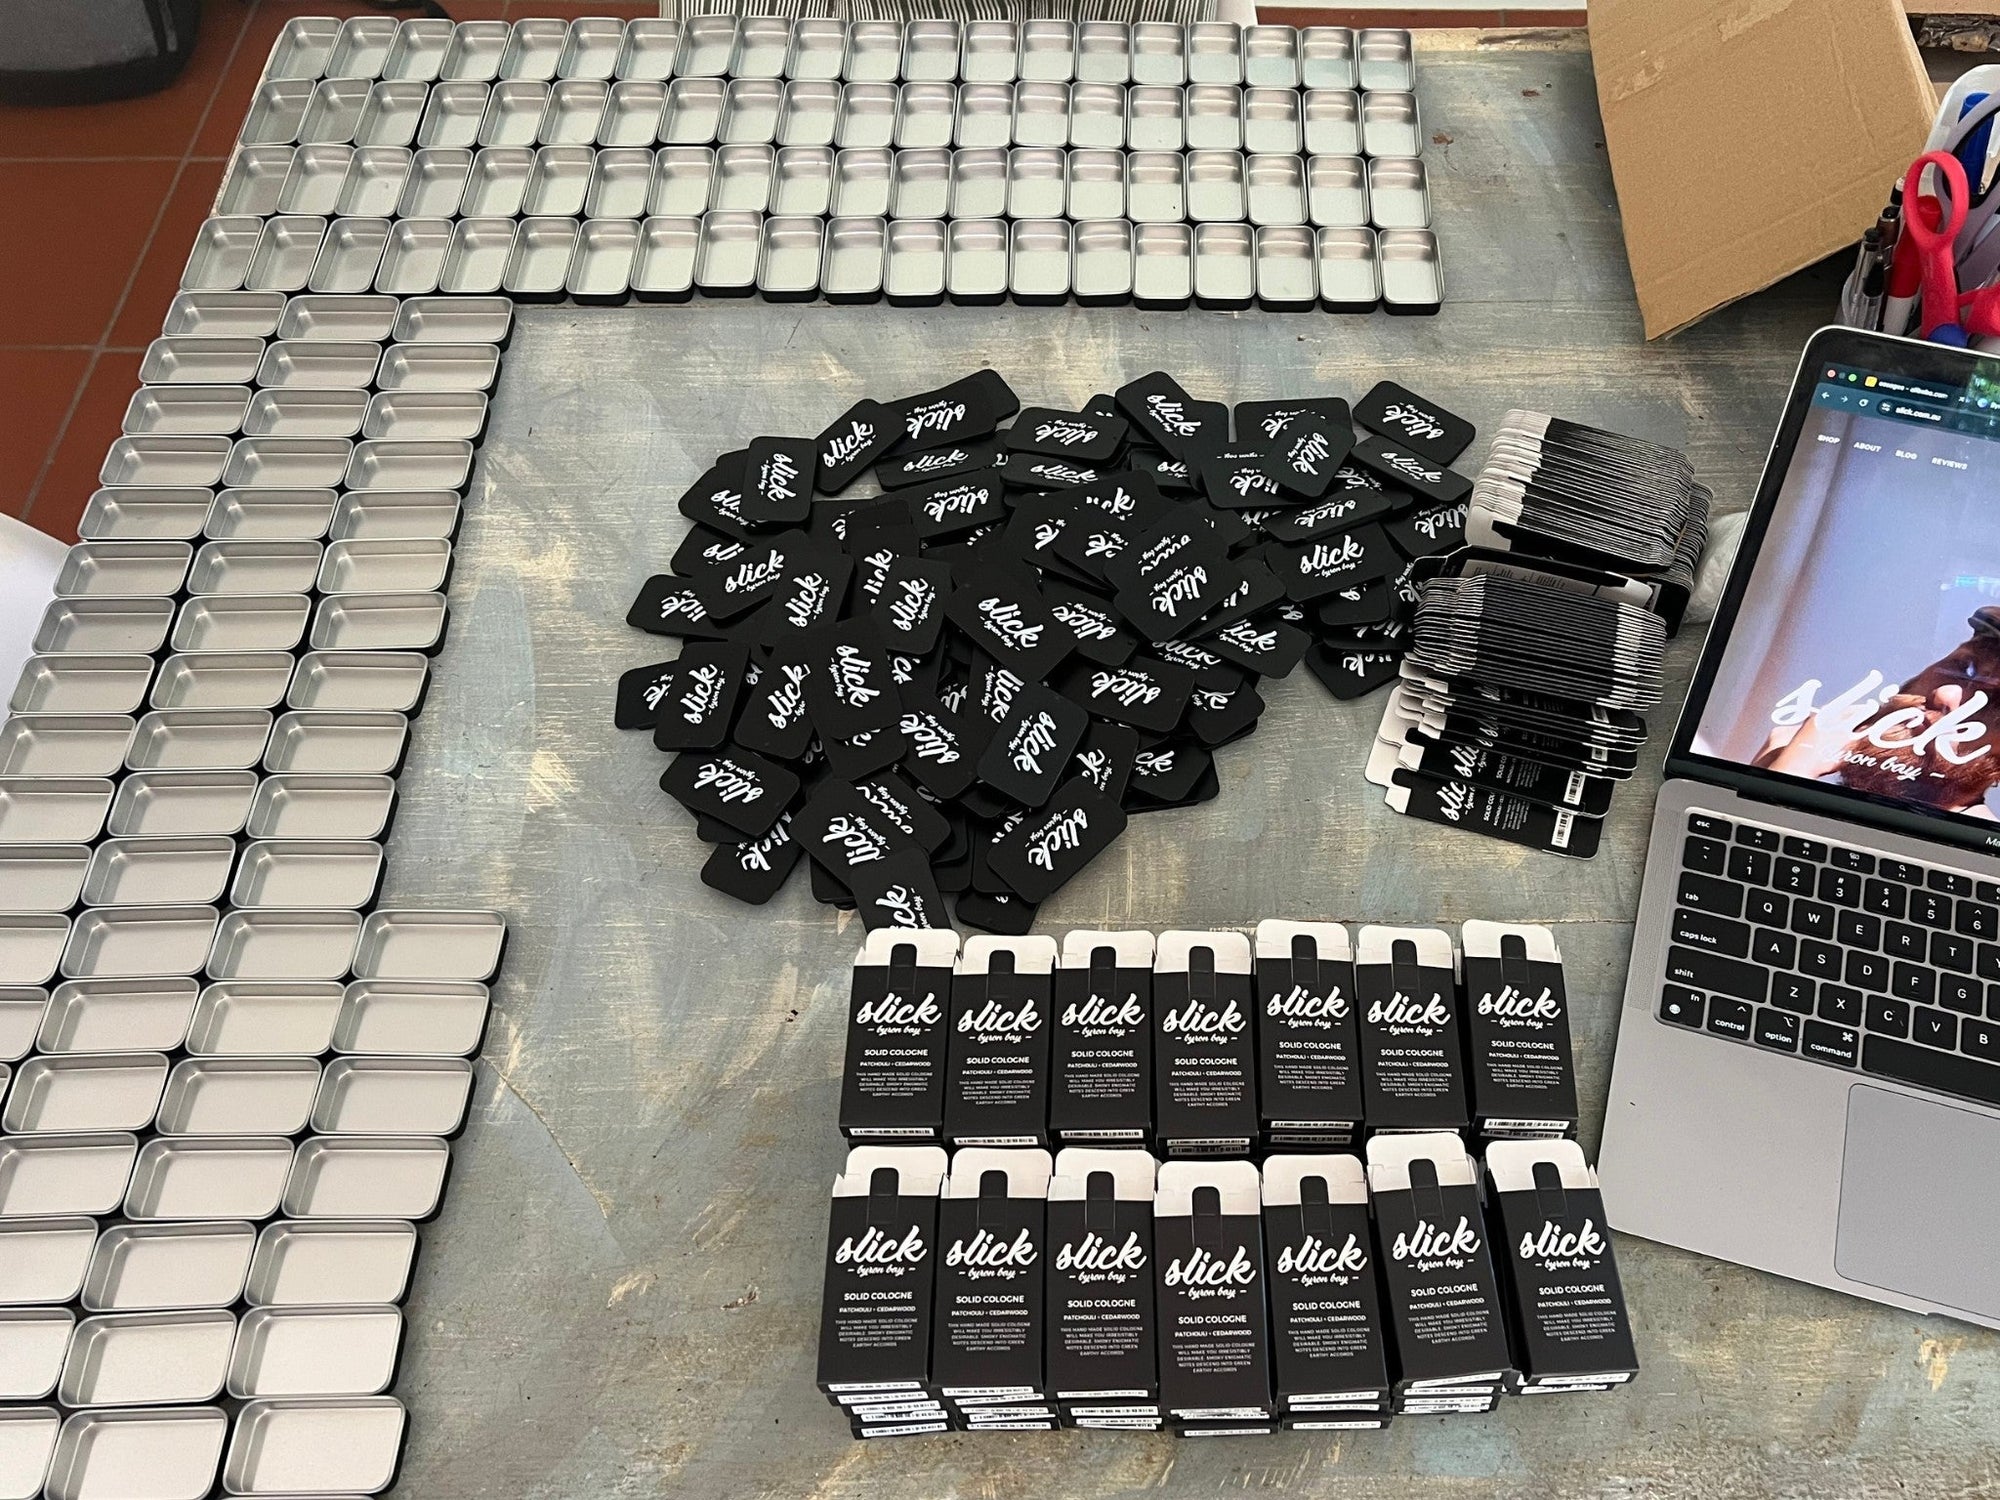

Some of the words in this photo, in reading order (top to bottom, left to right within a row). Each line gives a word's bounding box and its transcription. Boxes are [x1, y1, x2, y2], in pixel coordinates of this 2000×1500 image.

[906, 400, 966, 439] slick
[1147, 393, 1202, 436] slick
[1382, 402, 1446, 439] slick
[1035, 419, 1098, 446] slick
[822, 420, 874, 467] slick
[1292, 432, 1330, 475] slick
[1817, 434, 1840, 445] SHOP
[1854, 442, 1882, 452] ABOUT
[1895, 450, 1918, 460] BLOG
[1932, 457, 1968, 470] REVIEWS
[903, 449, 969, 472] slick
[1030, 464, 1098, 484] slick
[1381, 453, 1442, 483] slick
[767, 453, 799, 502] slick
[923, 485, 989, 522] slick
[1294, 500, 1356, 527] slick
[1300, 534, 1364, 574] slick
[720, 549, 784, 593] slick
[1152, 566, 1207, 619] slick
[785, 573, 824, 627] slick
[890, 578, 930, 631] slick
[978, 598, 1044, 649] slick
[1052, 603, 1116, 640] slick
[835, 645, 880, 707] slick
[680, 664, 720, 724] slick
[1091, 669, 1161, 706] slick
[767, 664, 811, 729] slick
[1771, 669, 1992, 765] slick
[900, 713, 960, 764] slick
[1013, 711, 1057, 774] slick
[1879, 759, 1922, 781] bay
[694, 759, 764, 803] slick
[1696, 820, 1710, 828] esc
[1027, 808, 1088, 870] slick
[1747, 866, 1752, 875] 1
[1791, 877, 1799, 887] 2
[1685, 893, 1699, 901] tab
[1836, 888, 1843, 897] 3
[1763, 902, 1773, 913] Q
[1881, 899, 1889, 908] 4
[1808, 913, 1820, 923] W
[1927, 909, 1935, 919] 5
[1856, 924, 1863, 935] E
[1973, 920, 1981, 930] 6
[1680, 931, 1699, 940] caps
[1700, 934, 1717, 944] lock
[1902, 935, 1910, 946] R
[1770, 943, 1780, 953] A
[1949, 947, 1957, 956] T
[1817, 954, 1826, 964] S
[1675, 969, 1693, 978] shift
[1863, 965, 1872, 975] D
[1911, 976, 1919, 986] F
[1691, 994, 1700, 1002] fn
[1790, 986, 1798, 998] Z
[1957, 988, 1966, 999] G
[856, 992, 942, 1024] slick
[1267, 985, 1350, 1018] slick
[1367, 991, 1451, 1025] slick
[1478, 985, 1561, 1019] slick
[1836, 998, 1845, 1009] X
[957, 999, 1042, 1032] slick
[1061, 993, 1145, 1026] slick
[1163, 999, 1246, 1032] slick
[1884, 1010, 1893, 1021] C
[876, 1025, 902, 1036] byron
[903, 1025, 921, 1036] bay
[1288, 1017, 1313, 1029] byron
[1314, 1018, 1331, 1030] bay
[1499, 1017, 1525, 1028] byron
[1526, 1018, 1543, 1030] bay
[1715, 1019, 1745, 1031] control
[1931, 1021, 1941, 1032] V
[977, 1033, 1003, 1044] byron
[1004, 1032, 1022, 1044] bay
[1081, 1026, 1107, 1038] byron
[1108, 1026, 1125, 1037] bay
[1389, 1025, 1414, 1036] byron
[1416, 1025, 1433, 1037] bay
[1765, 1032, 1792, 1043] option
[1184, 1033, 1209, 1045] byron
[1210, 1033, 1228, 1045] bay
[1279, 1041, 1303, 1049] SOLID
[1303, 1042, 1341, 1050] COLOGNE
[1516, 1041, 1554, 1050] COLOGNE
[1979, 1034, 1988, 1044] B
[1071, 1050, 1095, 1058] SOLID
[1405, 1049, 1444, 1057] COLOGNE
[1810, 1044, 1852, 1058] command
[991, 1056, 1029, 1064] COLOGNE
[835, 1225, 927, 1264] slick
[1392, 1216, 1481, 1261] slick
[1519, 1218, 1606, 1259] slick
[946, 1228, 1038, 1266] slick
[1056, 1231, 1147, 1270] slick
[1277, 1233, 1367, 1273] slick
[857, 1265, 884, 1278] byron
[885, 1264, 905, 1277] bay
[1165, 1245, 1256, 1286] slick
[1417, 1259, 1444, 1272] byron
[1445, 1257, 1464, 1270] bay
[1544, 1259, 1571, 1271] byron
[1572, 1257, 1590, 1270] bay
[968, 1267, 995, 1280] byron
[997, 1267, 1016, 1280] bay
[1078, 1271, 1106, 1284] byron
[1107, 1271, 1126, 1284] bay
[1301, 1274, 1328, 1287] byron
[1330, 1273, 1349, 1286] bay
[844, 1292, 870, 1301] SOLID
[871, 1291, 912, 1300] COLOGNE
[1188, 1287, 1215, 1300] byron
[1217, 1286, 1236, 1299] bay
[1411, 1287, 1436, 1297] SOLID
[1437, 1283, 1478, 1294] COLOGNE
[1539, 1286, 1564, 1295] SOLID
[1565, 1284, 1605, 1293] COLOGNE
[956, 1295, 982, 1304] SOLID
[983, 1295, 1024, 1303] COLOGNE
[1067, 1300, 1093, 1308] SOLID
[1094, 1299, 1136, 1307] COLOGNE
[1292, 1302, 1318, 1311] SOLID
[1319, 1300, 1361, 1310] COLOGNE
[1409, 1302, 1442, 1310] PATCHOULI
[1446, 1297, 1485, 1306] CEDARWOOD
[1574, 1298, 1612, 1306] CEDARWOOD
[1178, 1316, 1204, 1324] SOLID
[1205, 1315, 1247, 1324] COLOGNE
